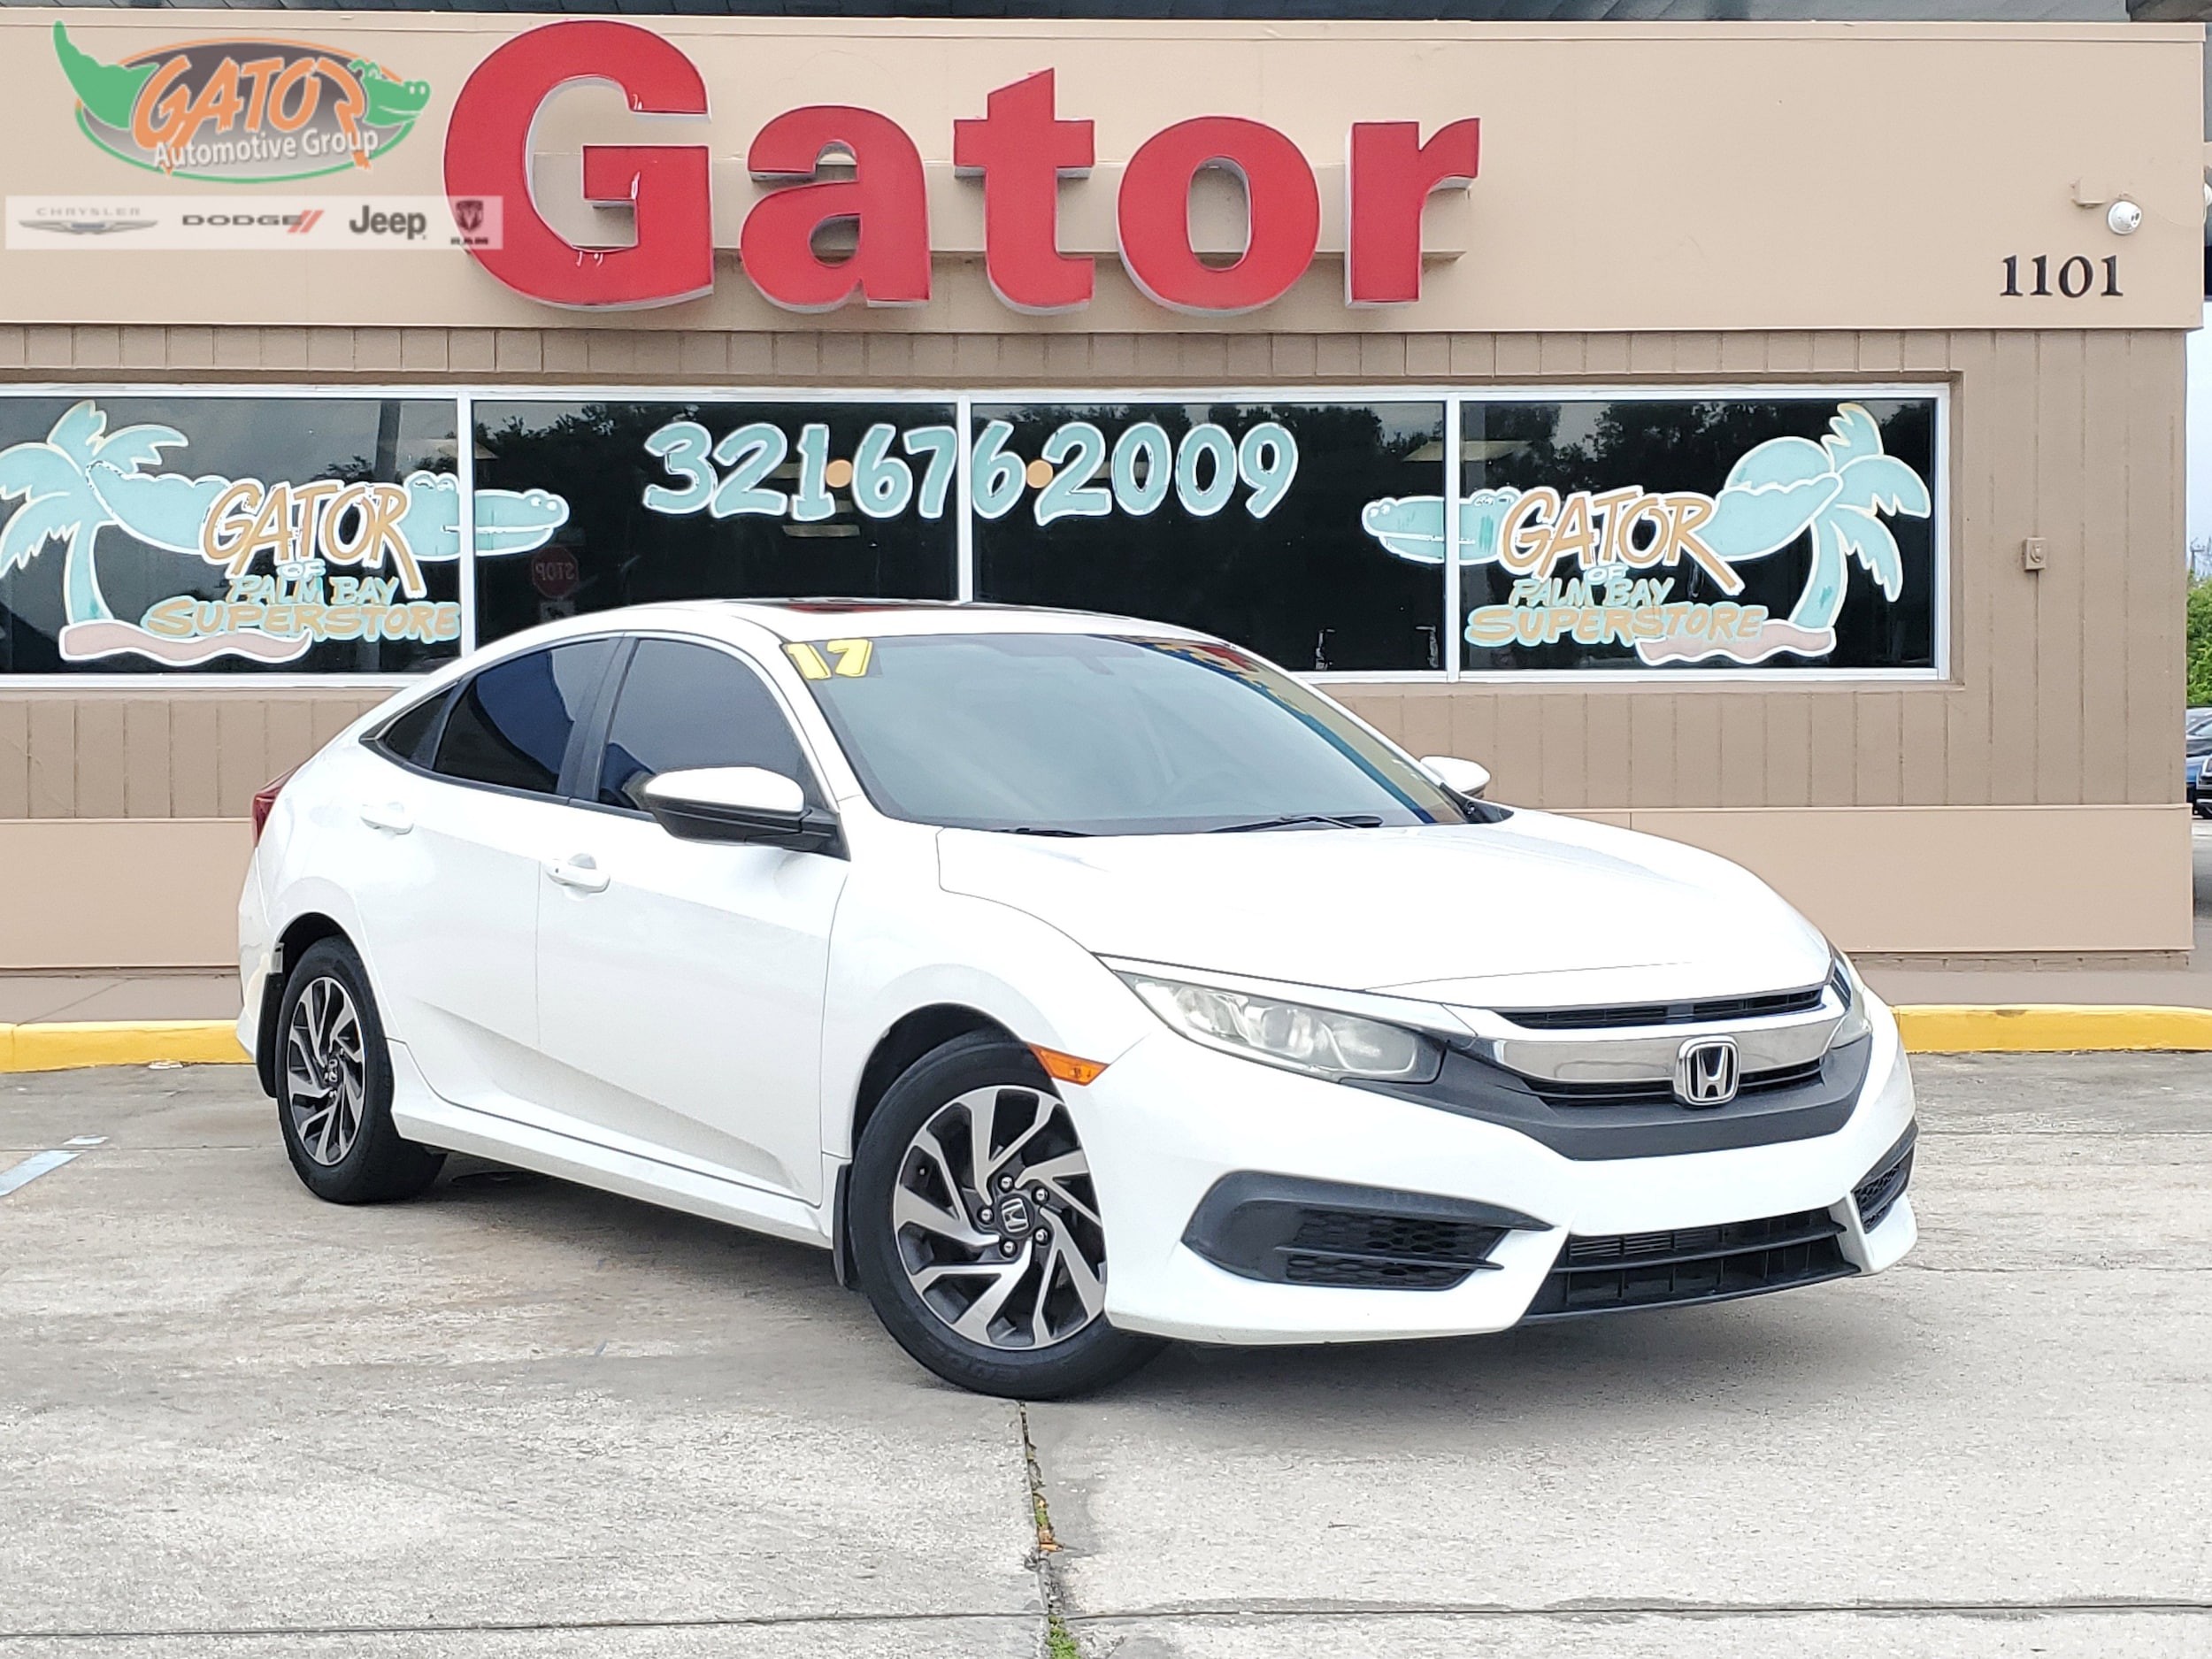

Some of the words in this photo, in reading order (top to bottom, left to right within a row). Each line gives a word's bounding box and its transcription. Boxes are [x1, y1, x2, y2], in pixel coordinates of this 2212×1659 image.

[443, 19, 1481, 313] Gator
[2001, 255, 2124, 299] 1101
[200, 477, 426, 598] GATOR
[1500, 485, 1746, 596] GATOR
[226, 575, 324, 605] PALM
[329, 576, 399, 606] BAY
[277, 558, 326, 580] OF
[1585, 563, 1630, 585] OF
[1509, 578, 1595, 608] PALM
[1602, 577, 1675, 608] BAY
[140, 595, 461, 643] SUPERSTORE
[1464, 601, 1769, 647] SUPERSTORE
[787, 638, 874, 680] 17
